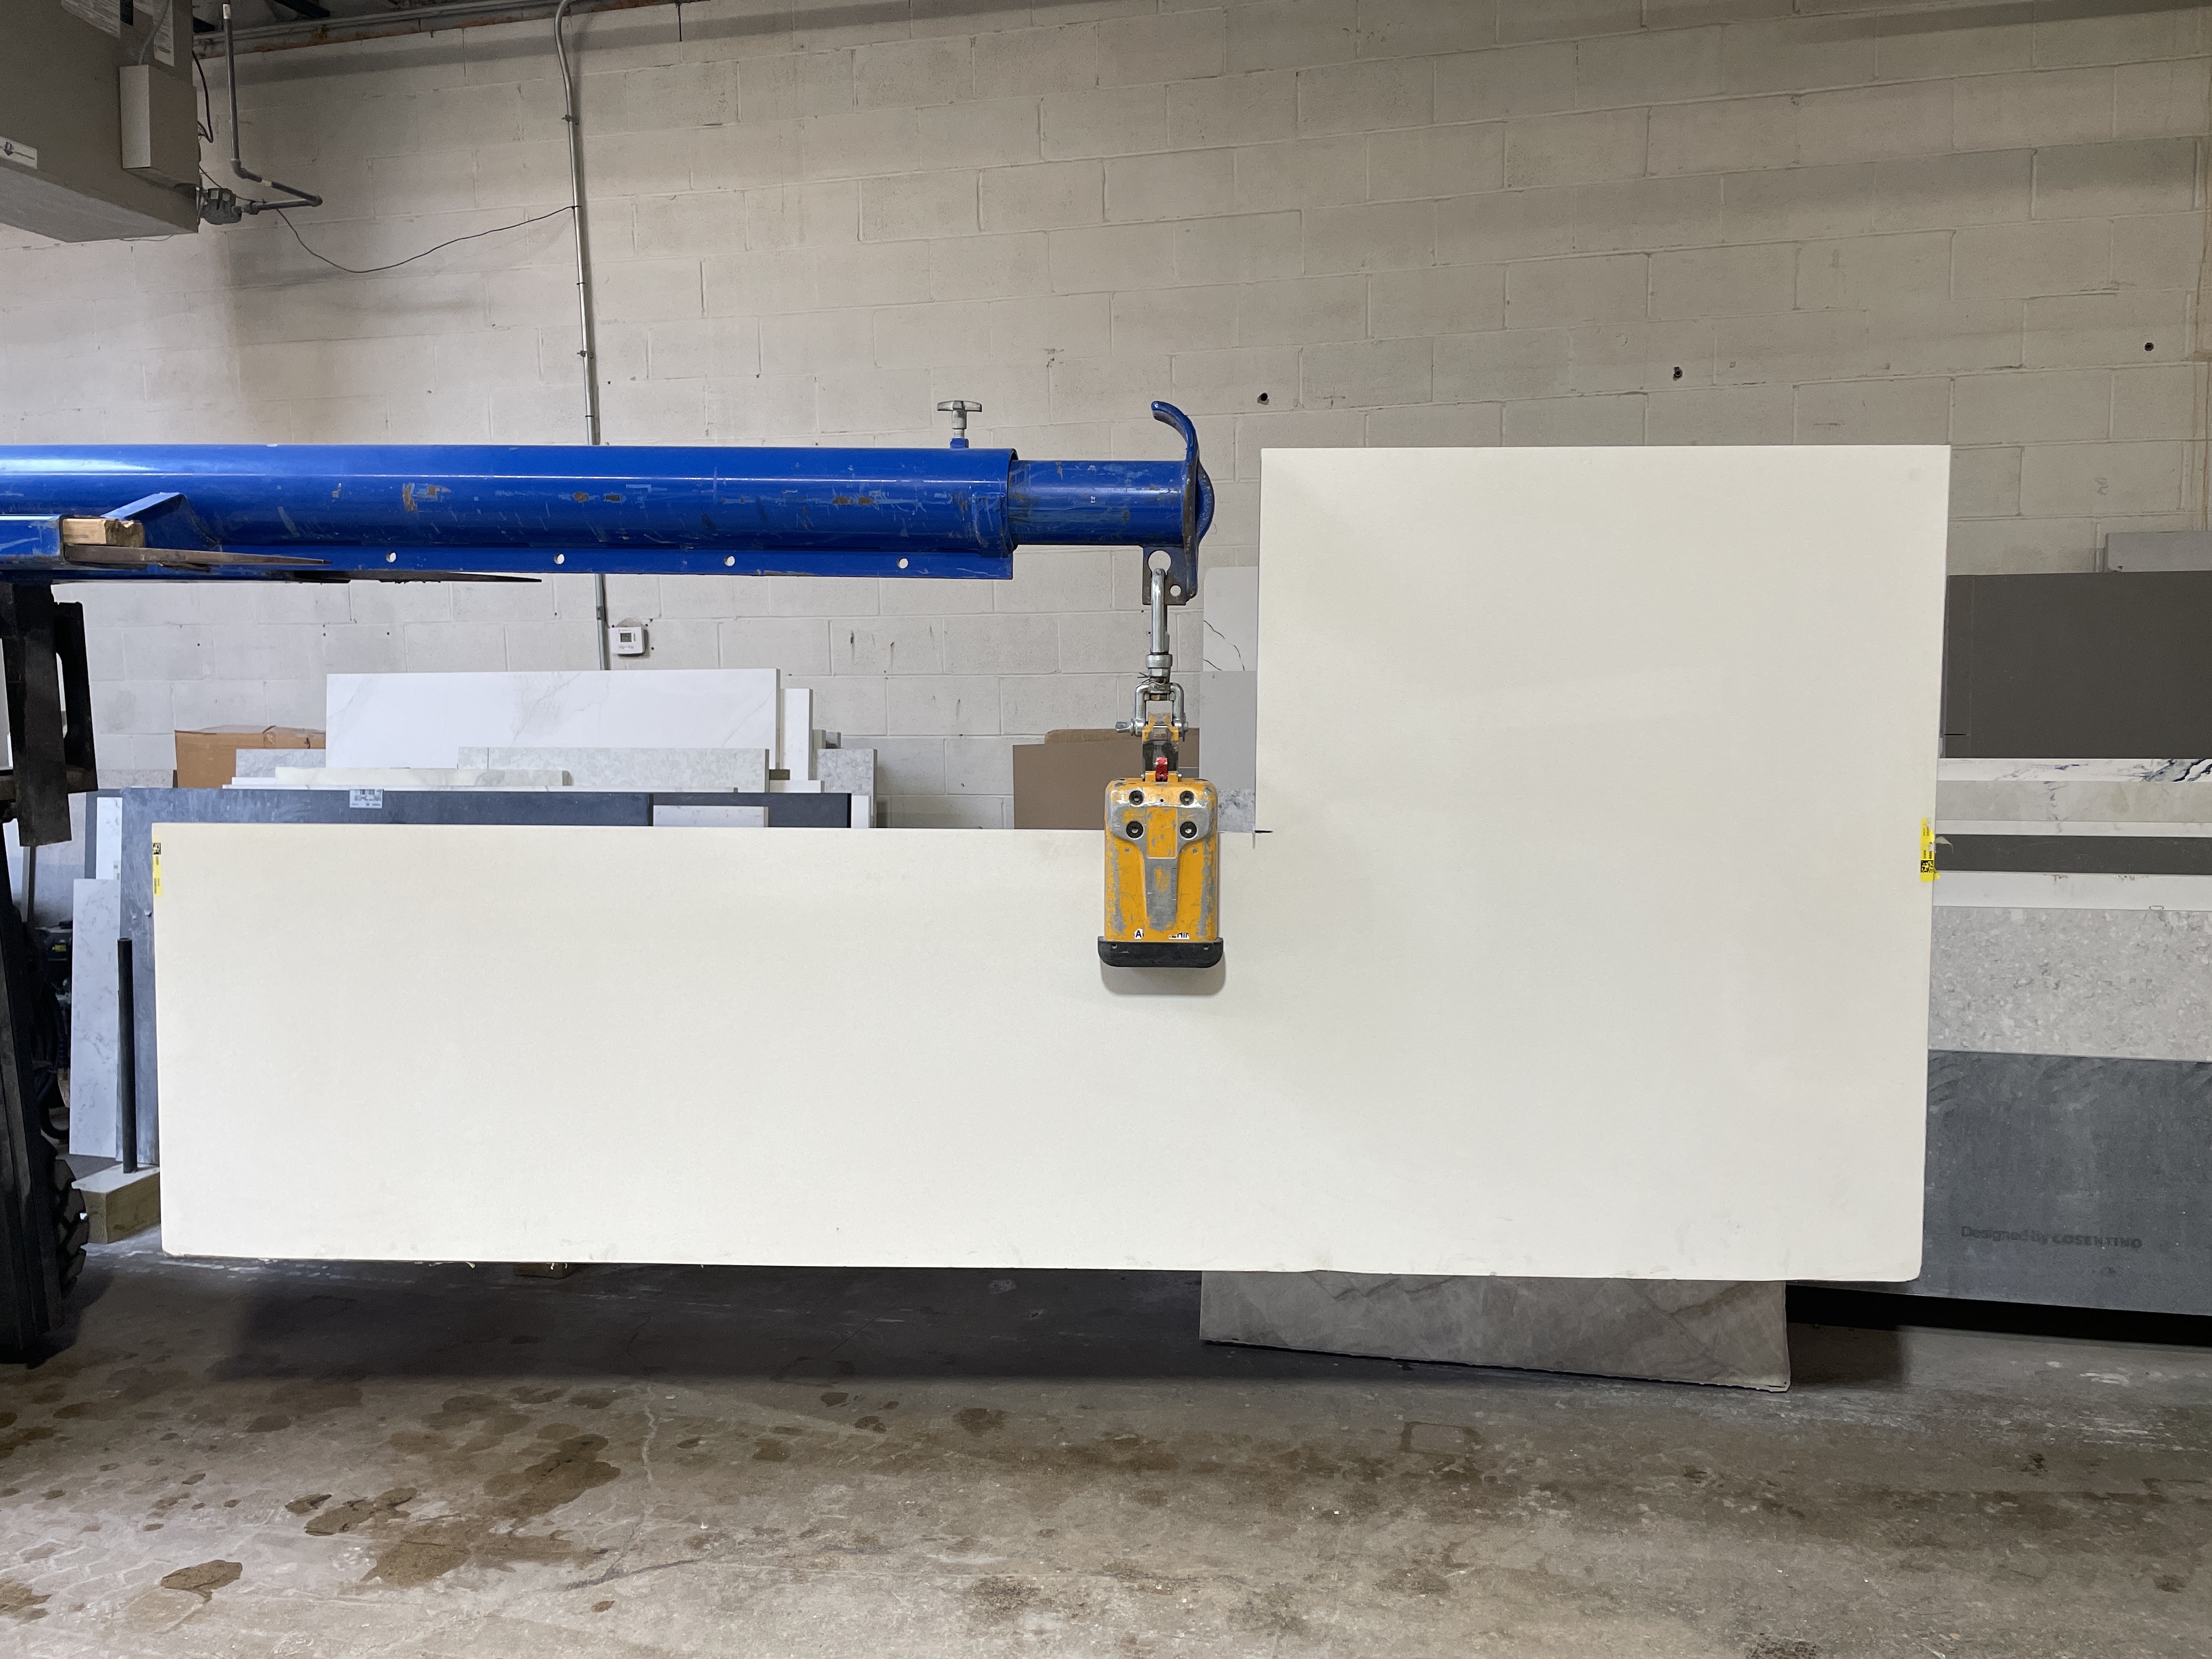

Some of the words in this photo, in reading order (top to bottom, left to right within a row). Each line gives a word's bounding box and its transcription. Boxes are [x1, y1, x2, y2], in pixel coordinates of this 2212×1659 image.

[1961, 1226, 2029, 1242] Designed
[2031, 1229, 2048, 1245] by
[2052, 1233, 2143, 1249] COSENTINO
